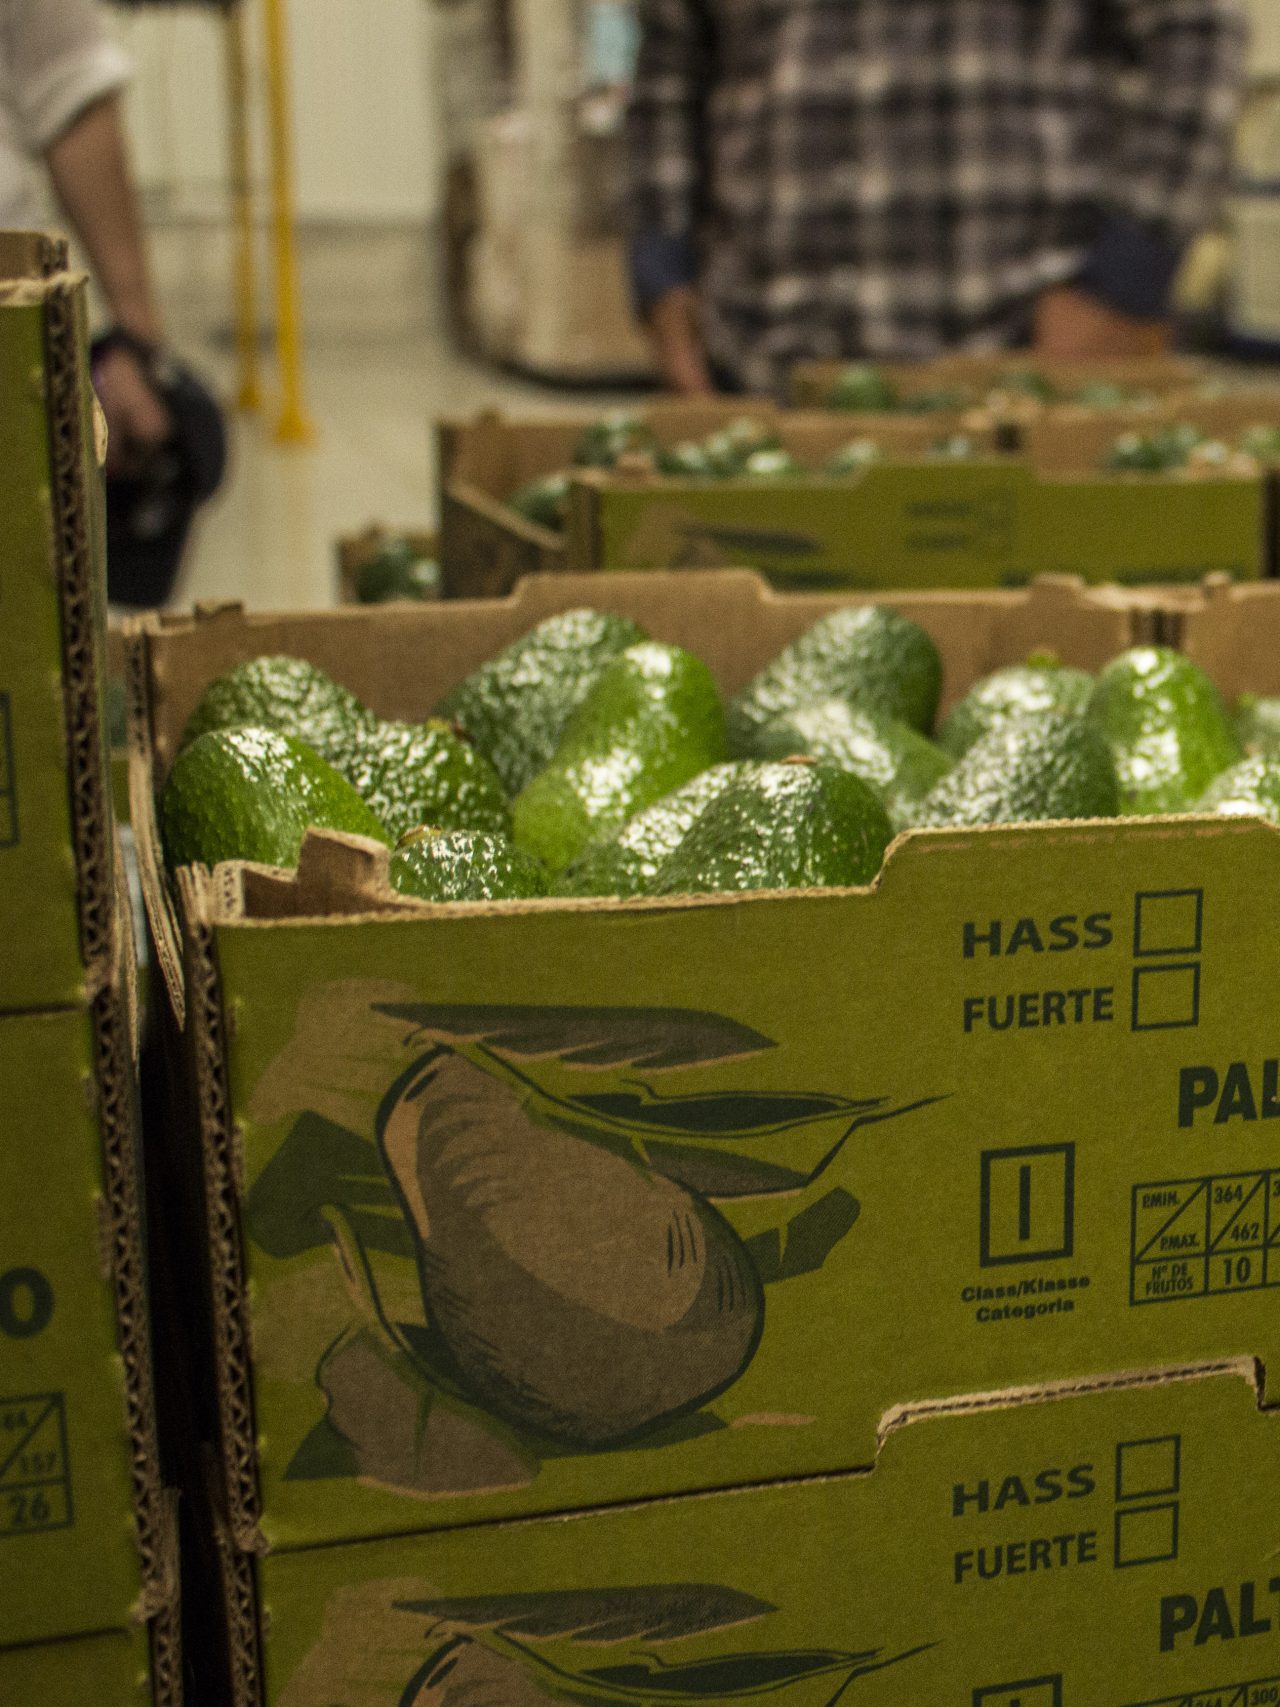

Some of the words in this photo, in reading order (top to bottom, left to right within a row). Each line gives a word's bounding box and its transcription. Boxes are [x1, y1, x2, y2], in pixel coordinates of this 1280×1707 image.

[963, 912, 1113, 958] HASS
[963, 987, 1114, 1032] FUERTE
[1214, 1184, 1243, 1204] 364
[1230, 1223, 1259, 1242] 462
[1172, 1263, 1188, 1277] DE
[1223, 1256, 1250, 1285] 10
[1145, 1276, 1194, 1296] FRUTOS
[976, 1297, 1075, 1322] Categoria
[952, 1464, 1095, 1516] HASS
[953, 1530, 1098, 1584] FUERTE
[1251, 1687, 1279, 1706] 300
